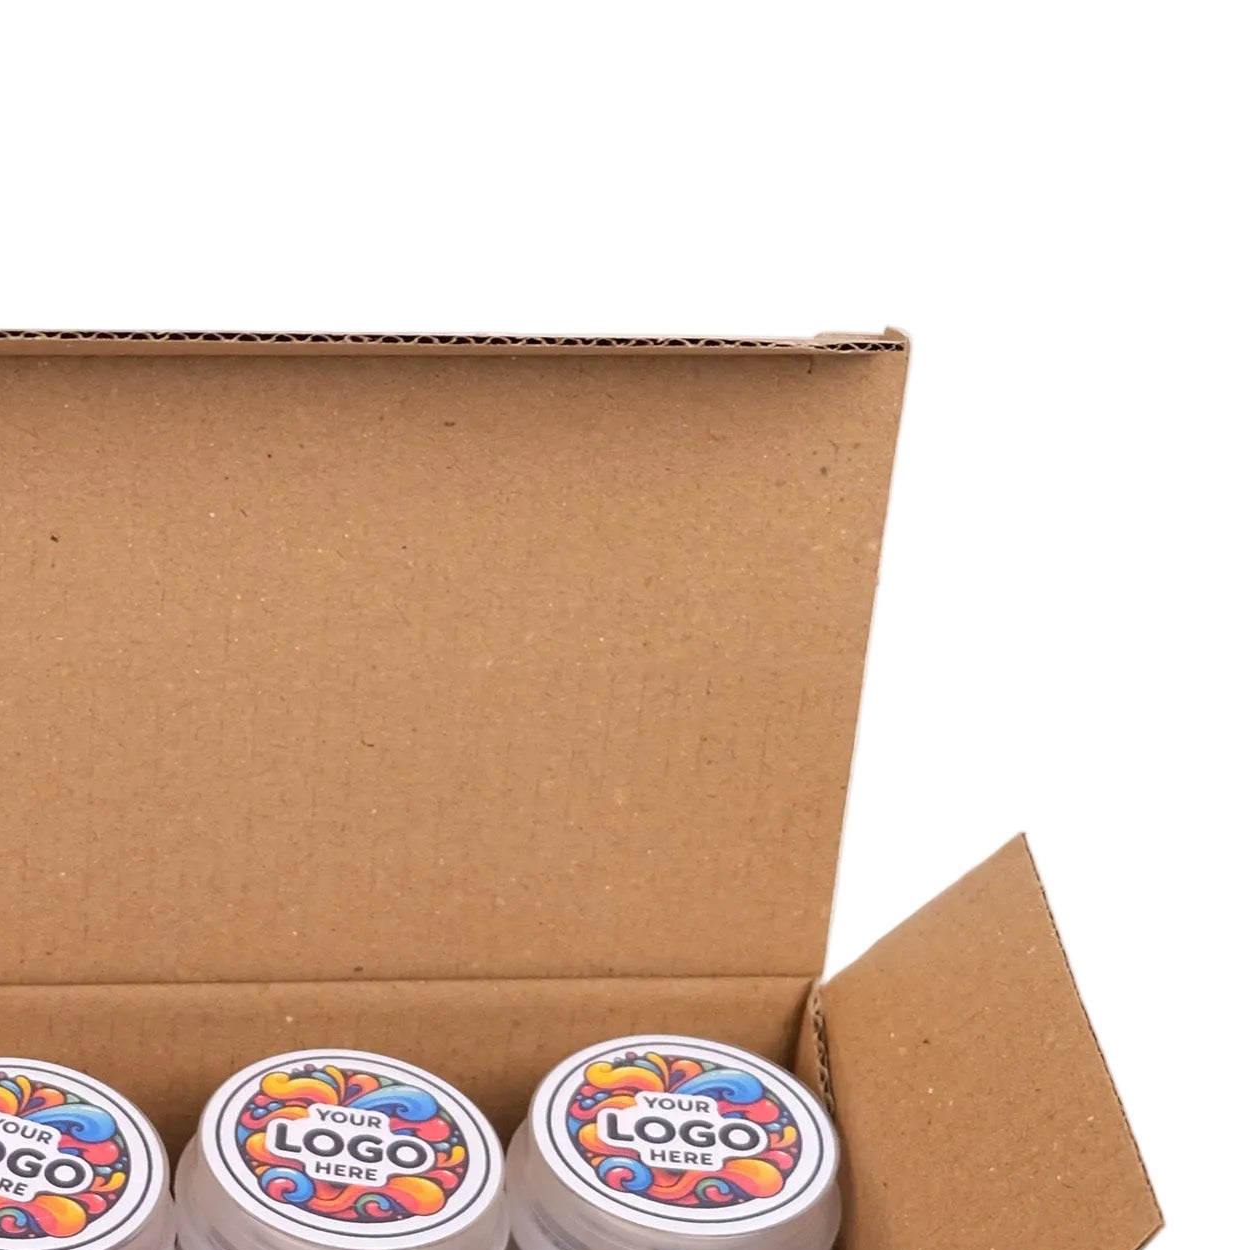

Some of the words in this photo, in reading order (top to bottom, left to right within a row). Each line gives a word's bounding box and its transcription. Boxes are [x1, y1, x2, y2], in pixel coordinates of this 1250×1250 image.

[645, 1097, 709, 1113] YOUR
[318, 1110, 381, 1129] YOUR
[607, 1113, 760, 1152] LOGO
[275, 1123, 428, 1169] LOGO
[650, 1149, 712, 1166] HERE
[315, 1162, 377, 1181] HERE
